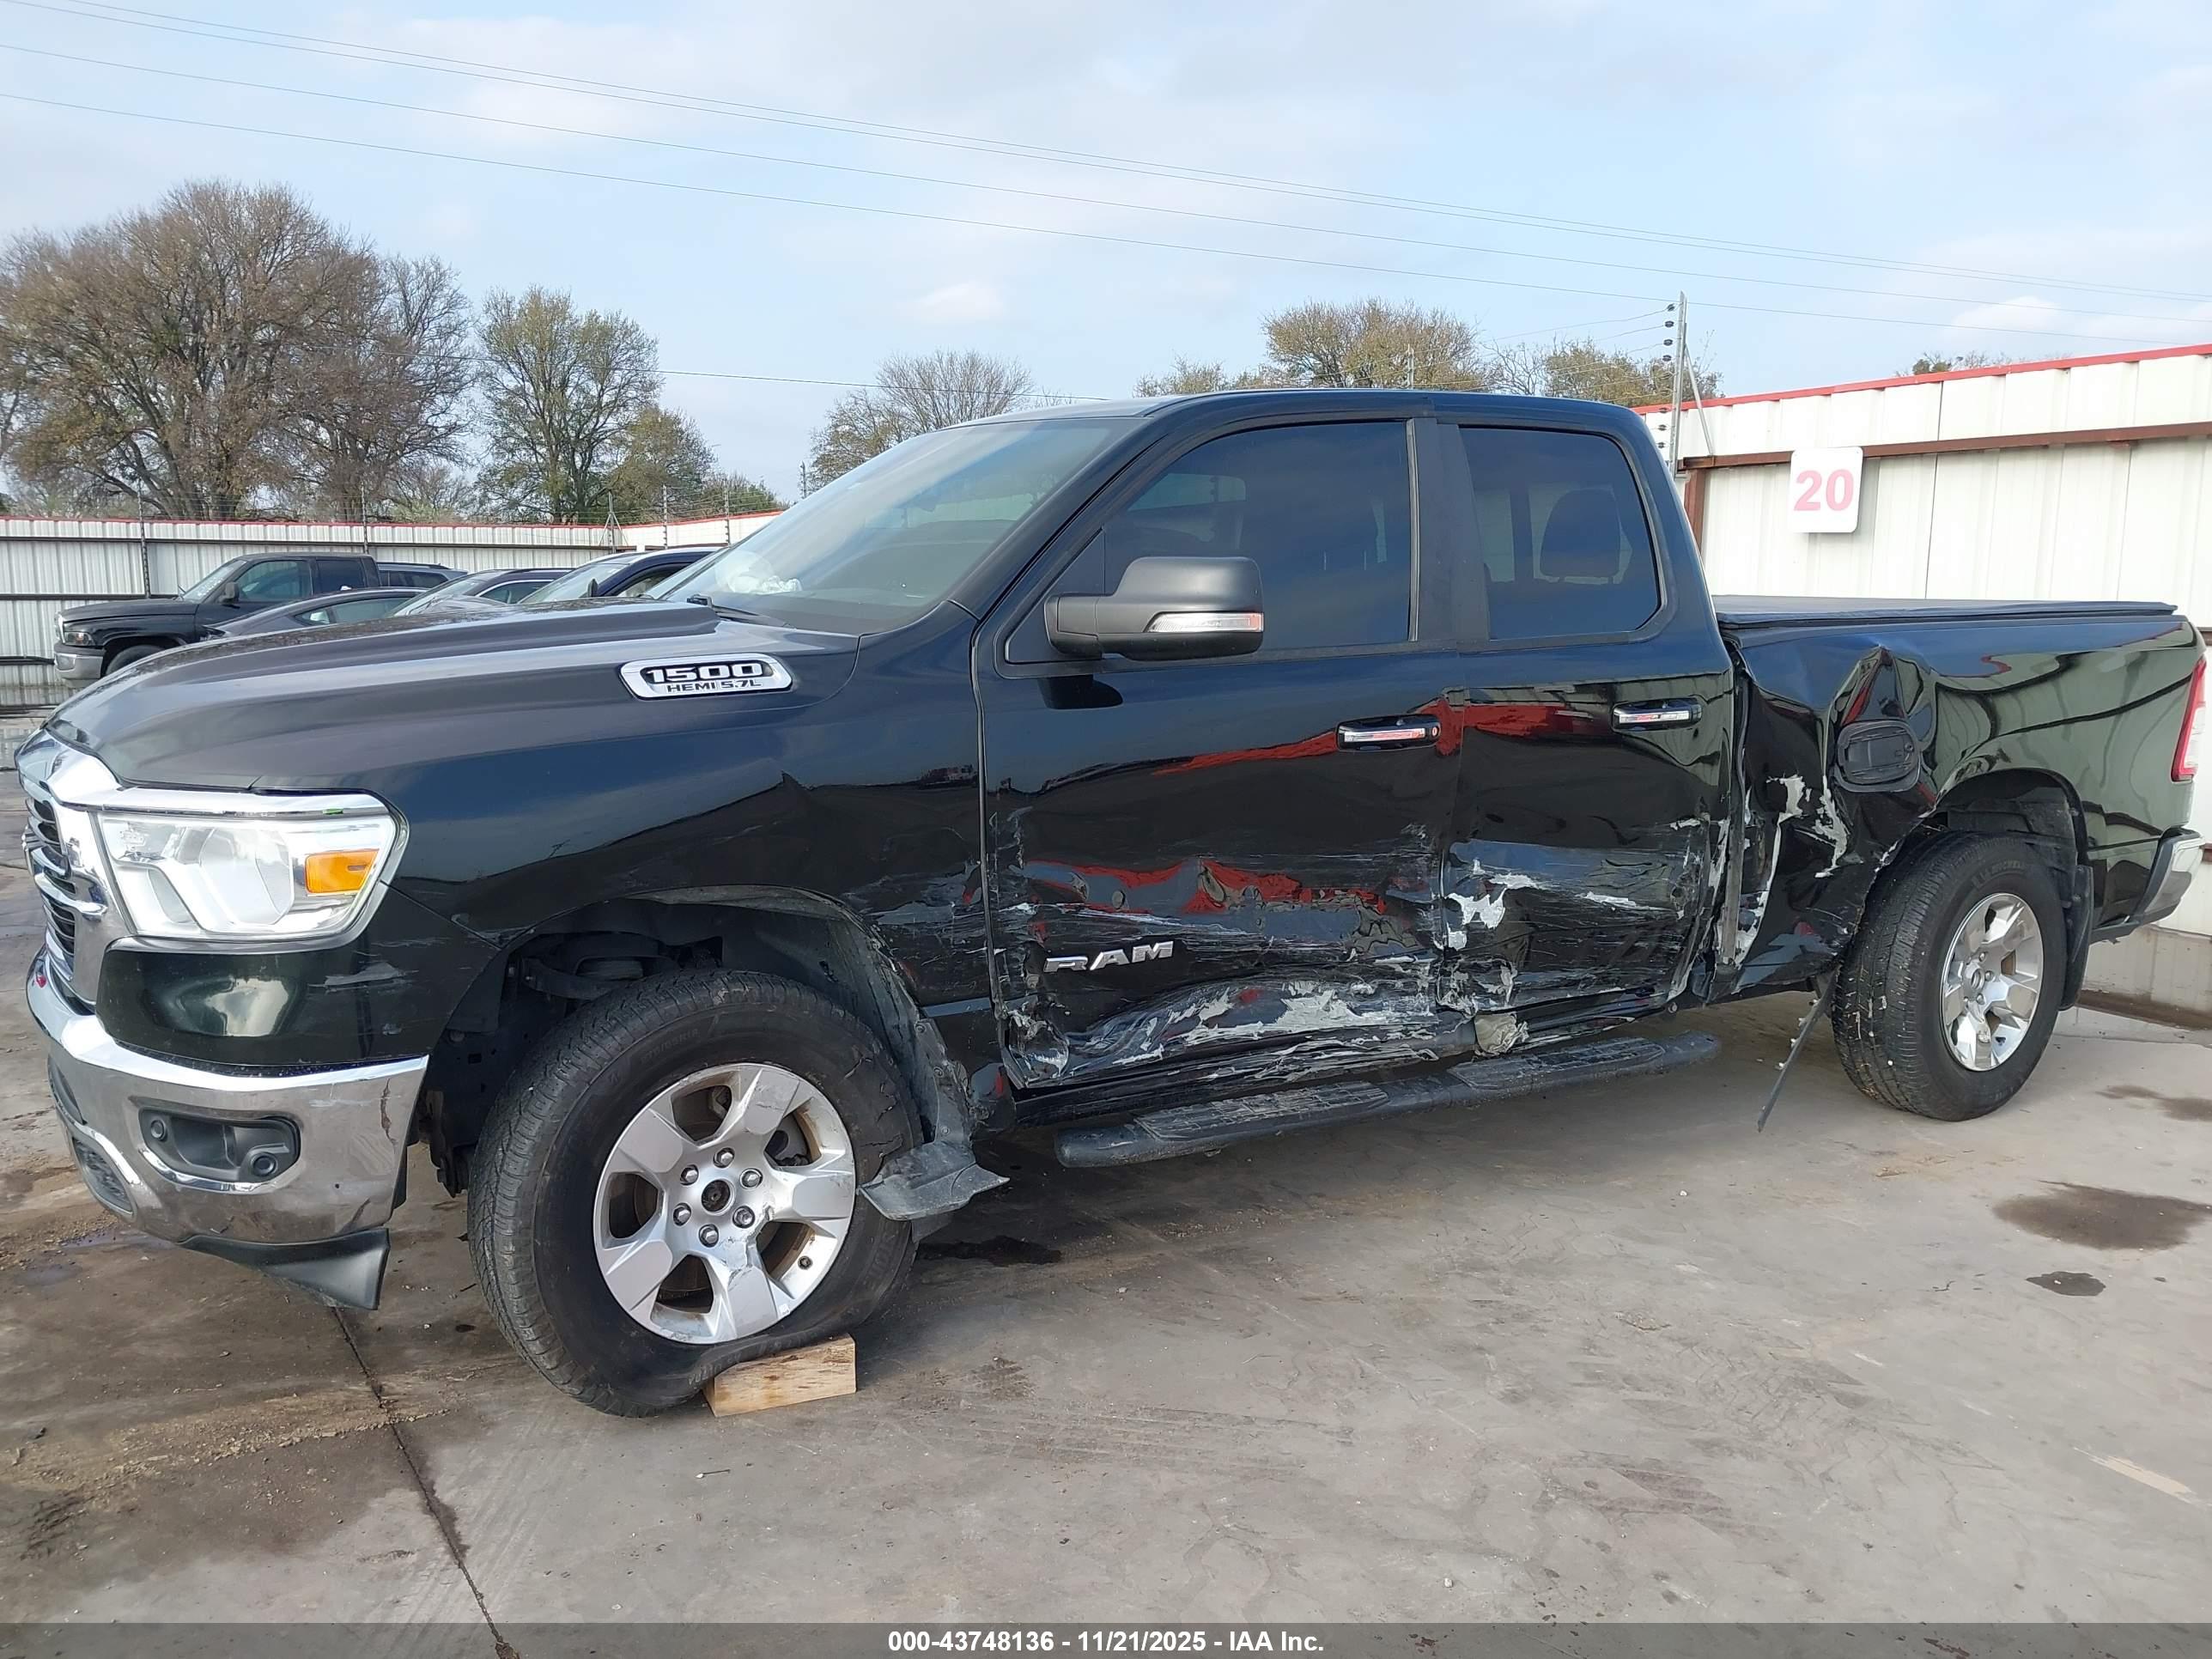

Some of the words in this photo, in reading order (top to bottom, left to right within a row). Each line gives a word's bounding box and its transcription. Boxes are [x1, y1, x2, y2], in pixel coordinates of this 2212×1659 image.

[1794, 469, 1854, 511] 20
[647, 662, 763, 684] 1500
[667, 683, 716, 693] HEMI
[722, 679, 762, 690] 5.7L
[1043, 940, 1174, 973] RAM
